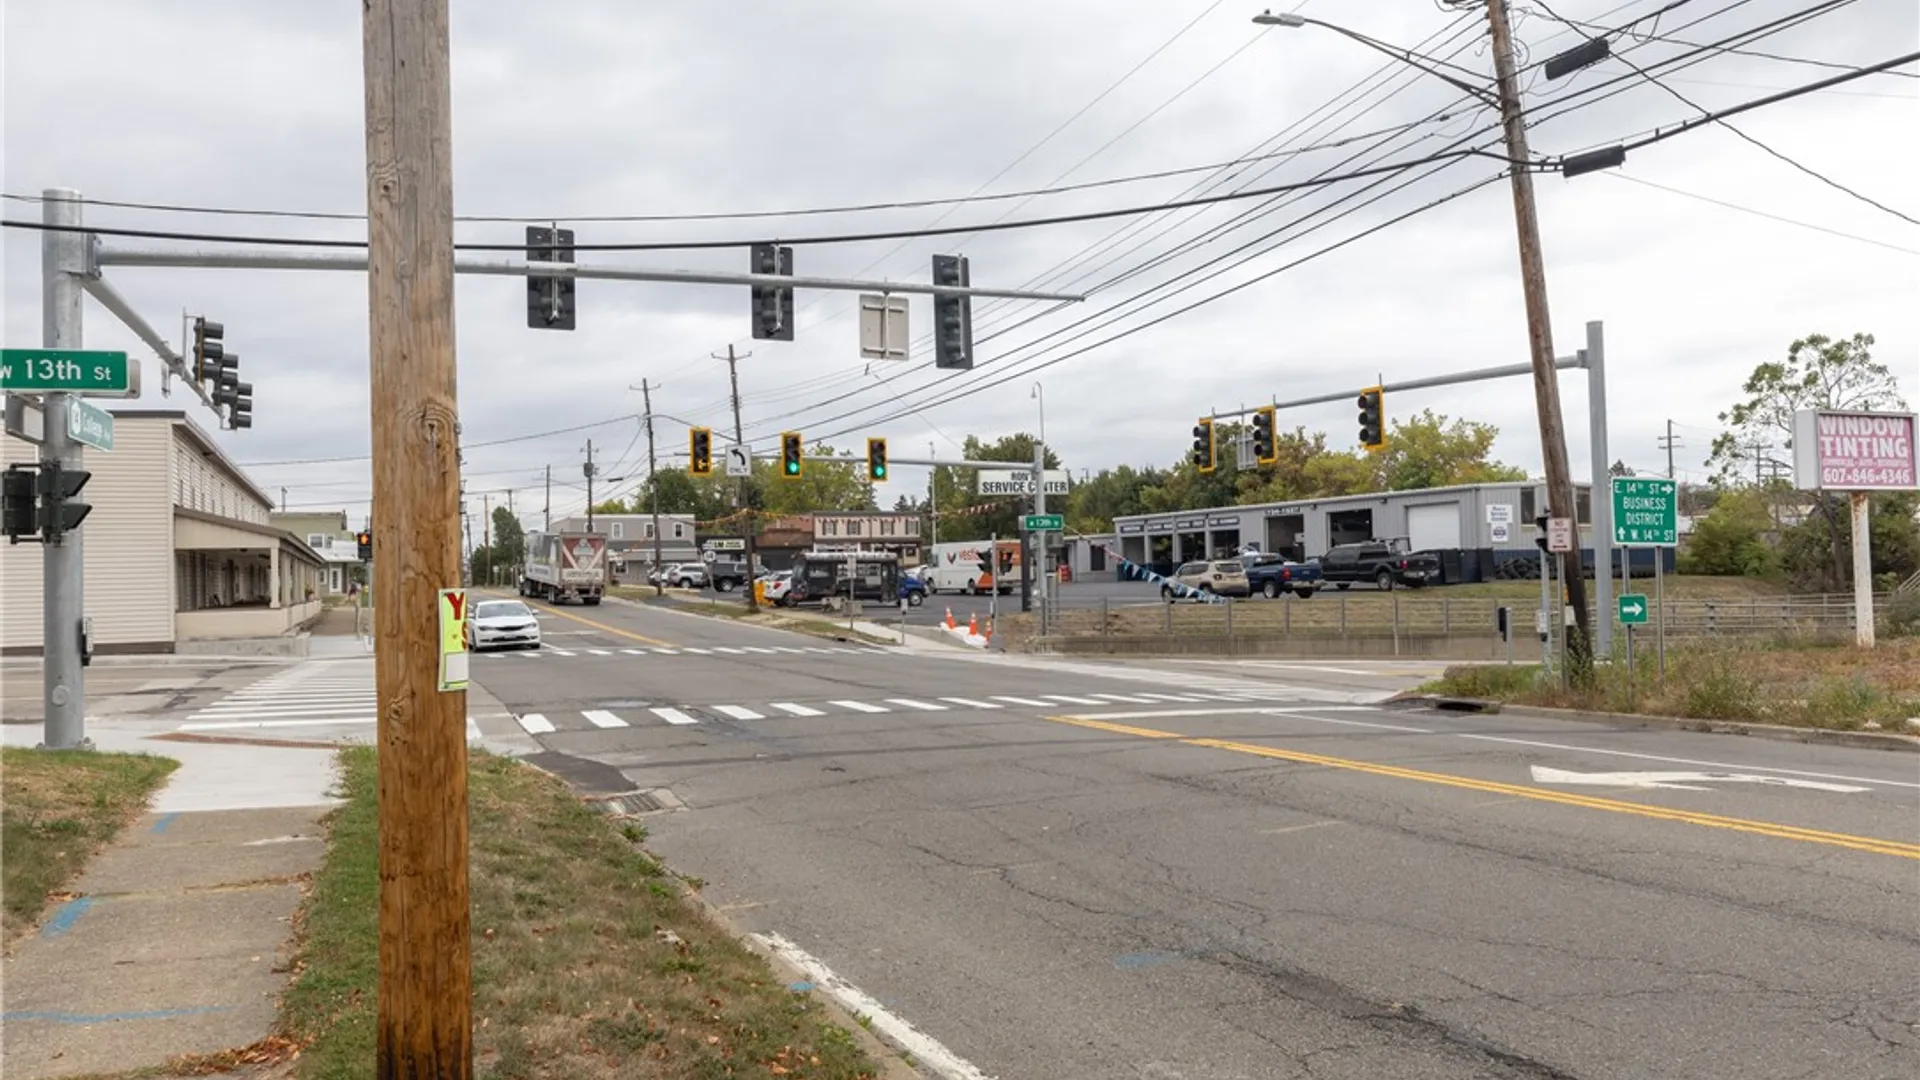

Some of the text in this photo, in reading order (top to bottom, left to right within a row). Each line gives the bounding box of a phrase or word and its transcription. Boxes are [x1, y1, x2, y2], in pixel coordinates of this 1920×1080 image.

[25, 359, 82, 380] 13th
[93, 366, 112, 381] St
[1819, 415, 1905, 437] WINDOW
[1820, 435, 1909, 458] TINTING
[729, 466, 749, 474] ONLY
[982, 481, 1025, 494] SERVICE
[1648, 483, 1660, 495] ST
[1623, 496, 1667, 511] BUSINESS
[1626, 511, 1665, 526] DISTRICT
[1664, 529, 1674, 541] ST
